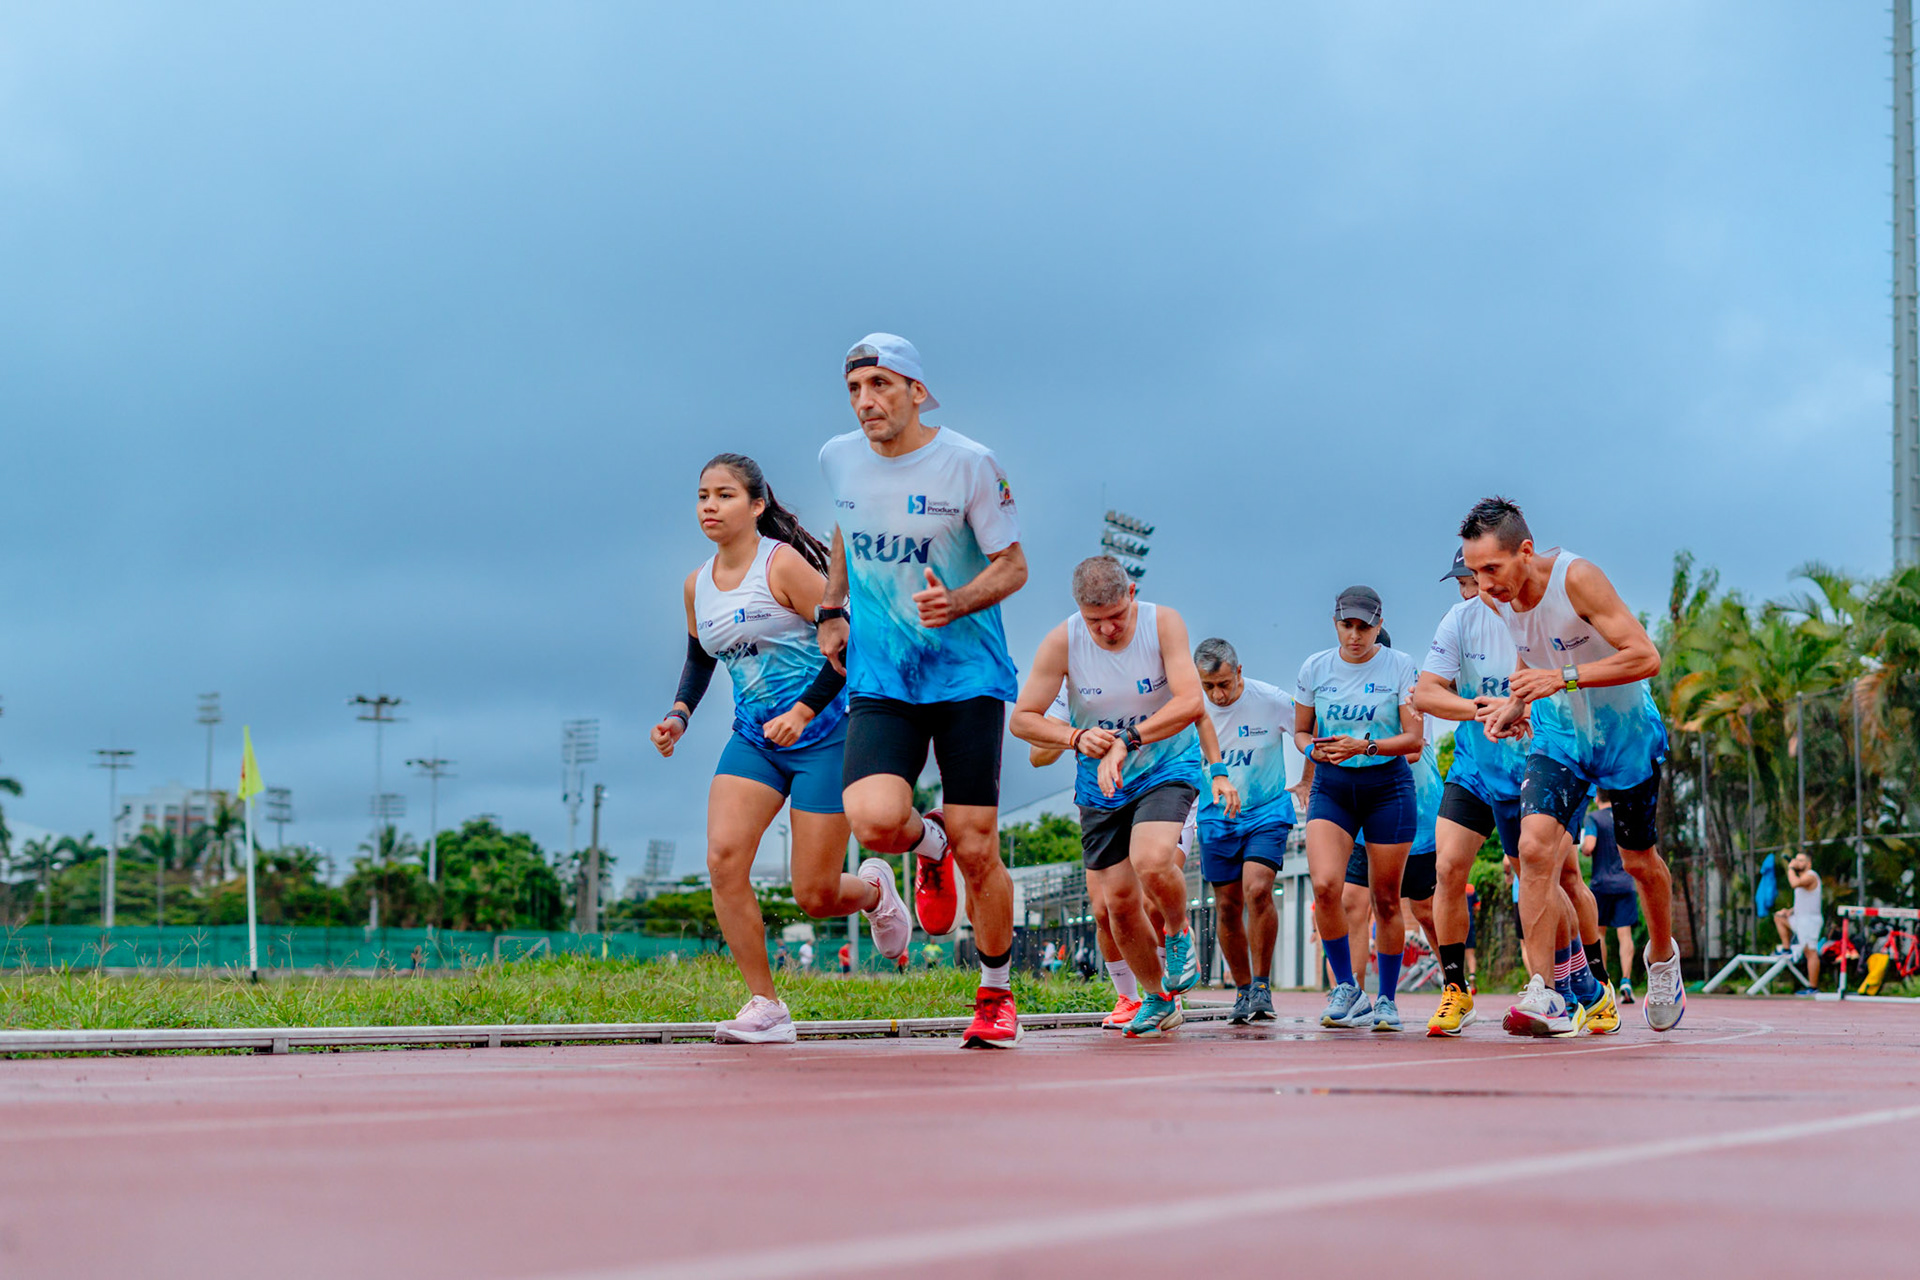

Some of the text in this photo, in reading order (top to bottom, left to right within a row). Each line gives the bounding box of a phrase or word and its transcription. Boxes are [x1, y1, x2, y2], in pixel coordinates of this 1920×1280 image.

[852, 530, 936, 564] RUN
[1481, 675, 1511, 698] RU
[1326, 703, 1379, 721] RUN
